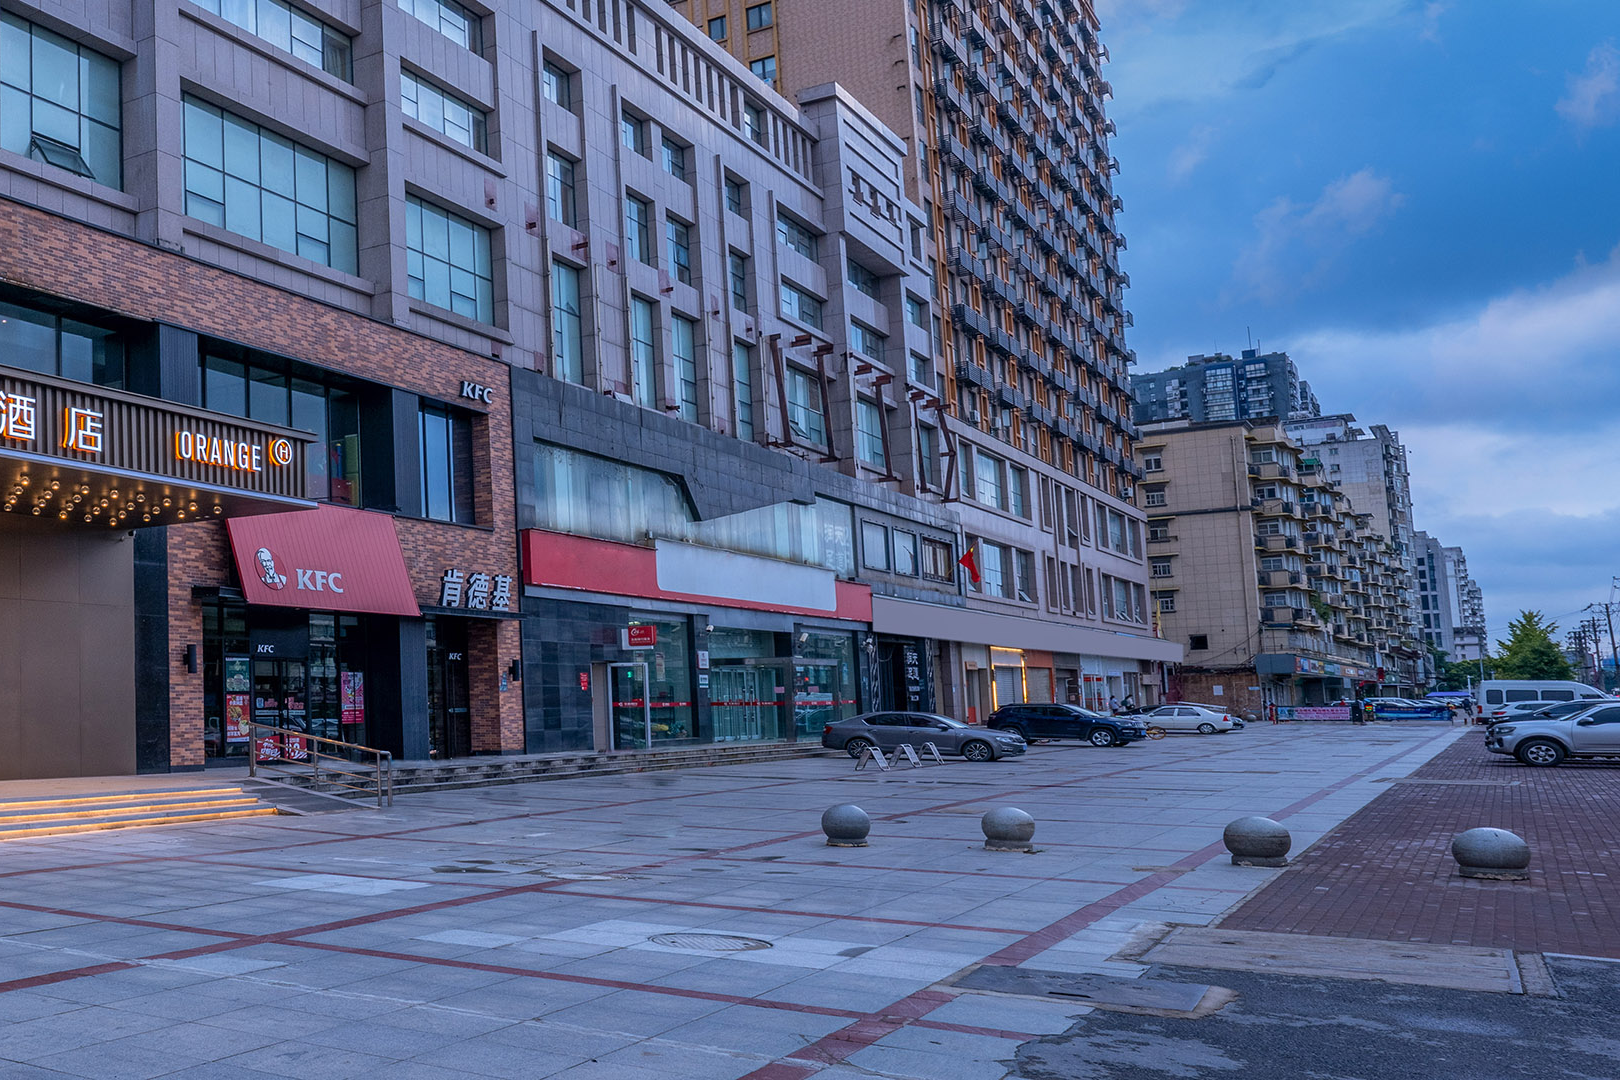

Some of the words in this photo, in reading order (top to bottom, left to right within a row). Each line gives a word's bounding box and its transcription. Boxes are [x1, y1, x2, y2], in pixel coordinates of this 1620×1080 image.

[461, 381, 493, 404] KFC
[179, 431, 261, 471] ORANGE
[296, 568, 344, 593] KFC
[441, 569, 513, 611] 肯德基
[257, 644, 274, 653] KFC
